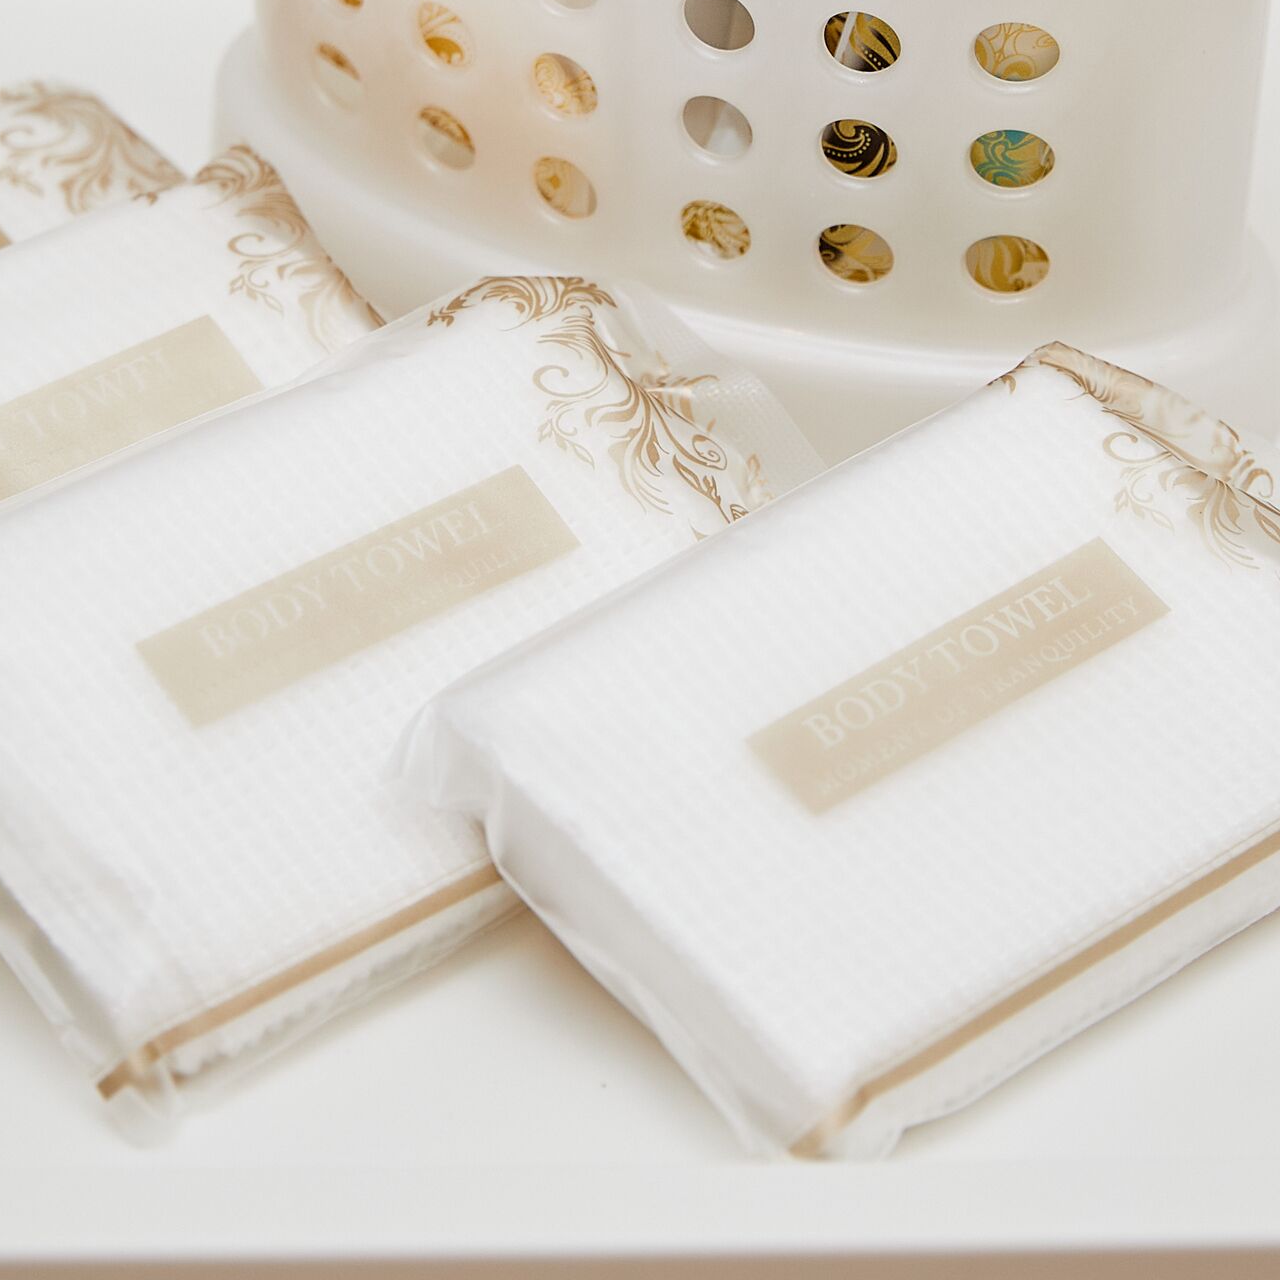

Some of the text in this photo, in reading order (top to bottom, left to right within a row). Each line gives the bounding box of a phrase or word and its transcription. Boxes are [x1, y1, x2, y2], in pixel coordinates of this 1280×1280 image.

[198, 574, 328, 659] BODY
[329, 500, 504, 593] TOWEL
[977, 594, 1143, 701] TRANQUILITY
[801, 576, 1094, 749] BODY TOWEL
